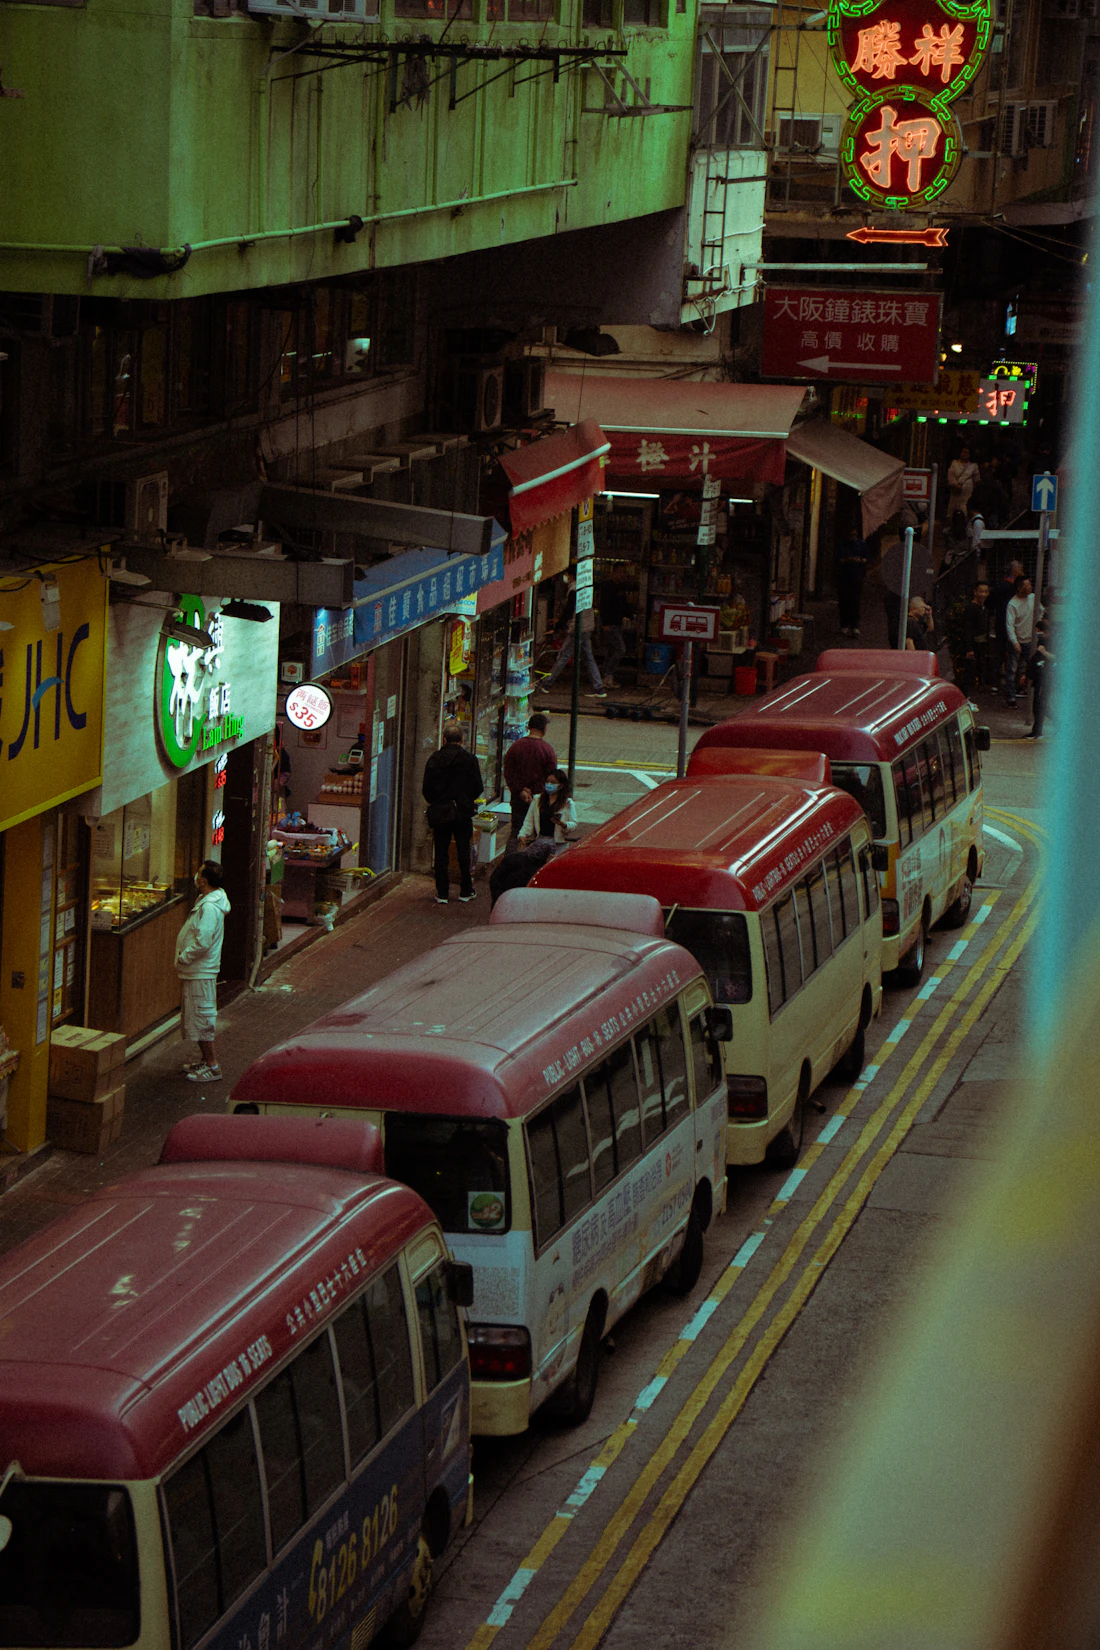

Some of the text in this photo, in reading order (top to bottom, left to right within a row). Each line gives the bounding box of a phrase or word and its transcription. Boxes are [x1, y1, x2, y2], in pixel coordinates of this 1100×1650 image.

[860, 105, 942, 193] 押
[772, 295, 930, 328] 大阪鐘錶珠寶
[801, 330, 900, 353] 高價 收購
[8, 622, 90, 762] JHC
[202, 712, 244, 751] Lam Hing
[177, 1391, 210, 1433] PUBLIC
[203, 1373, 229, 1409] LIGHT
[222, 1360, 243, 1391] BUS
[246, 1334, 273, 1370] SEATS
[316, 1532, 357, 1624] 8126
[361, 1483, 399, 1570] 8126
